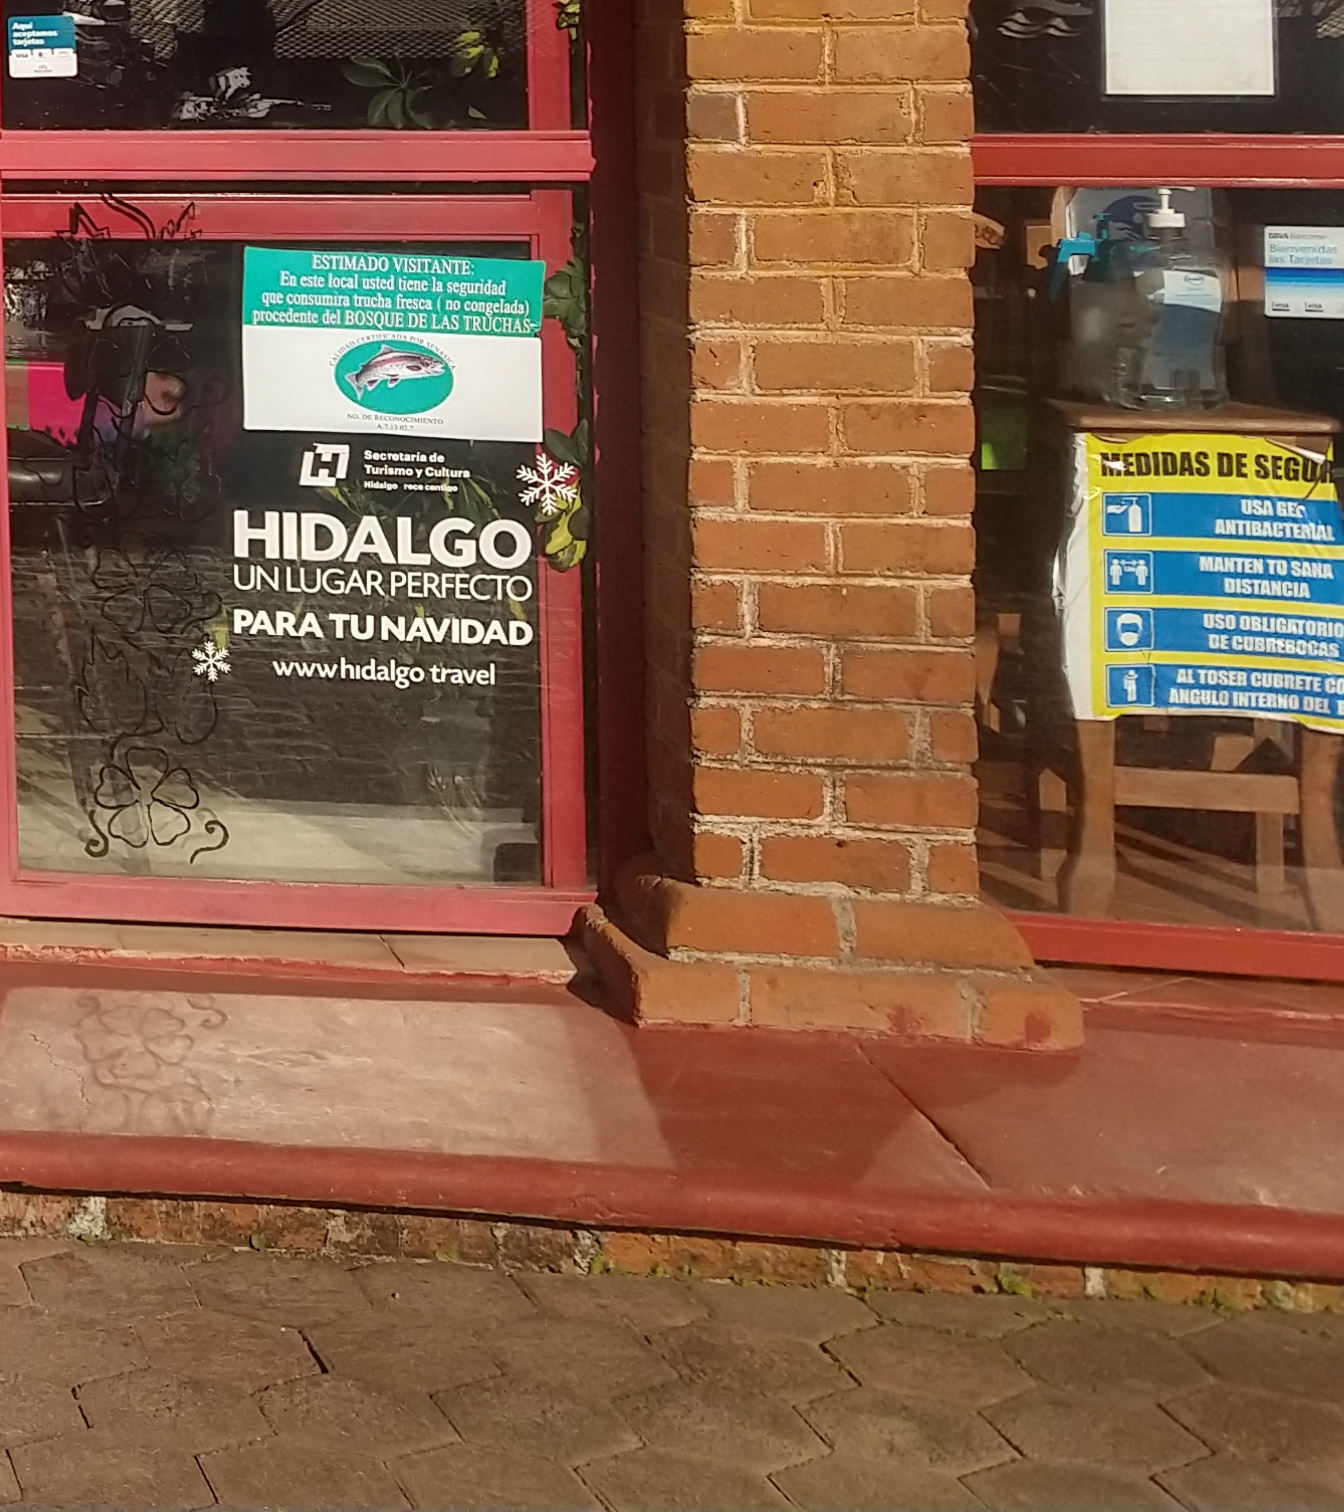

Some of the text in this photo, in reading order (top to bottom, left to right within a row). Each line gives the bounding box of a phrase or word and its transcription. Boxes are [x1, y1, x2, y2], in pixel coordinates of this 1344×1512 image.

[12, 30, 58, 39] aceptamos
[12, 38, 45, 47] tarjetas
[1270, 243, 1338, 254] Bienvenidas
[312, 254, 475, 275] ESTIMADO VISITANTE:
[1288, 255, 1333, 266] Tarjetas
[279, 270, 506, 296] En este local usted tiene la seguridad
[261, 291, 529, 317] que consumira trucha fresca no congelada)
[252, 308, 531, 334] procedente del BOSQUE DE LAS TRUCHAS
[329, 340, 356, 367] CALIDAD
[356, 333, 407, 344] CERTIFICADA
[409, 335, 424, 345] POR
[374, 414, 444, 425] RECONOCIMIENTO
[429, 452, 445, 463] de
[1100, 451, 1210, 478] MEDIDAS
[1217, 452, 1248, 479] DE
[364, 464, 471, 479] Turismo y Cultura
[364, 481, 398, 491] Hidalgo
[425, 484, 458, 492] contigo
[1241, 499, 1273, 516] USA
[233, 510, 532, 569] HIDALGO
[1215, 519, 1335, 541] ANTIBACTERIAL
[1199, 556, 1334, 579] MANTEN TU SANA
[233, 564, 533, 602] UN LUGAR PERFECTO
[1224, 578, 1311, 599] DISTANCIA
[233, 609, 533, 646] PARA TU NAVIDAD
[1203, 613, 1343, 638] USO OBLIGATORIO
[1208, 634, 1340, 658] DE CUBREBOCAS
[1176, 668, 1195, 685] AL
[1198, 669, 1247, 686] TOSER
[1250, 672, 1322, 692] CUBRETE
[1169, 688, 1331, 714] ANGULO INTERNO DEL
